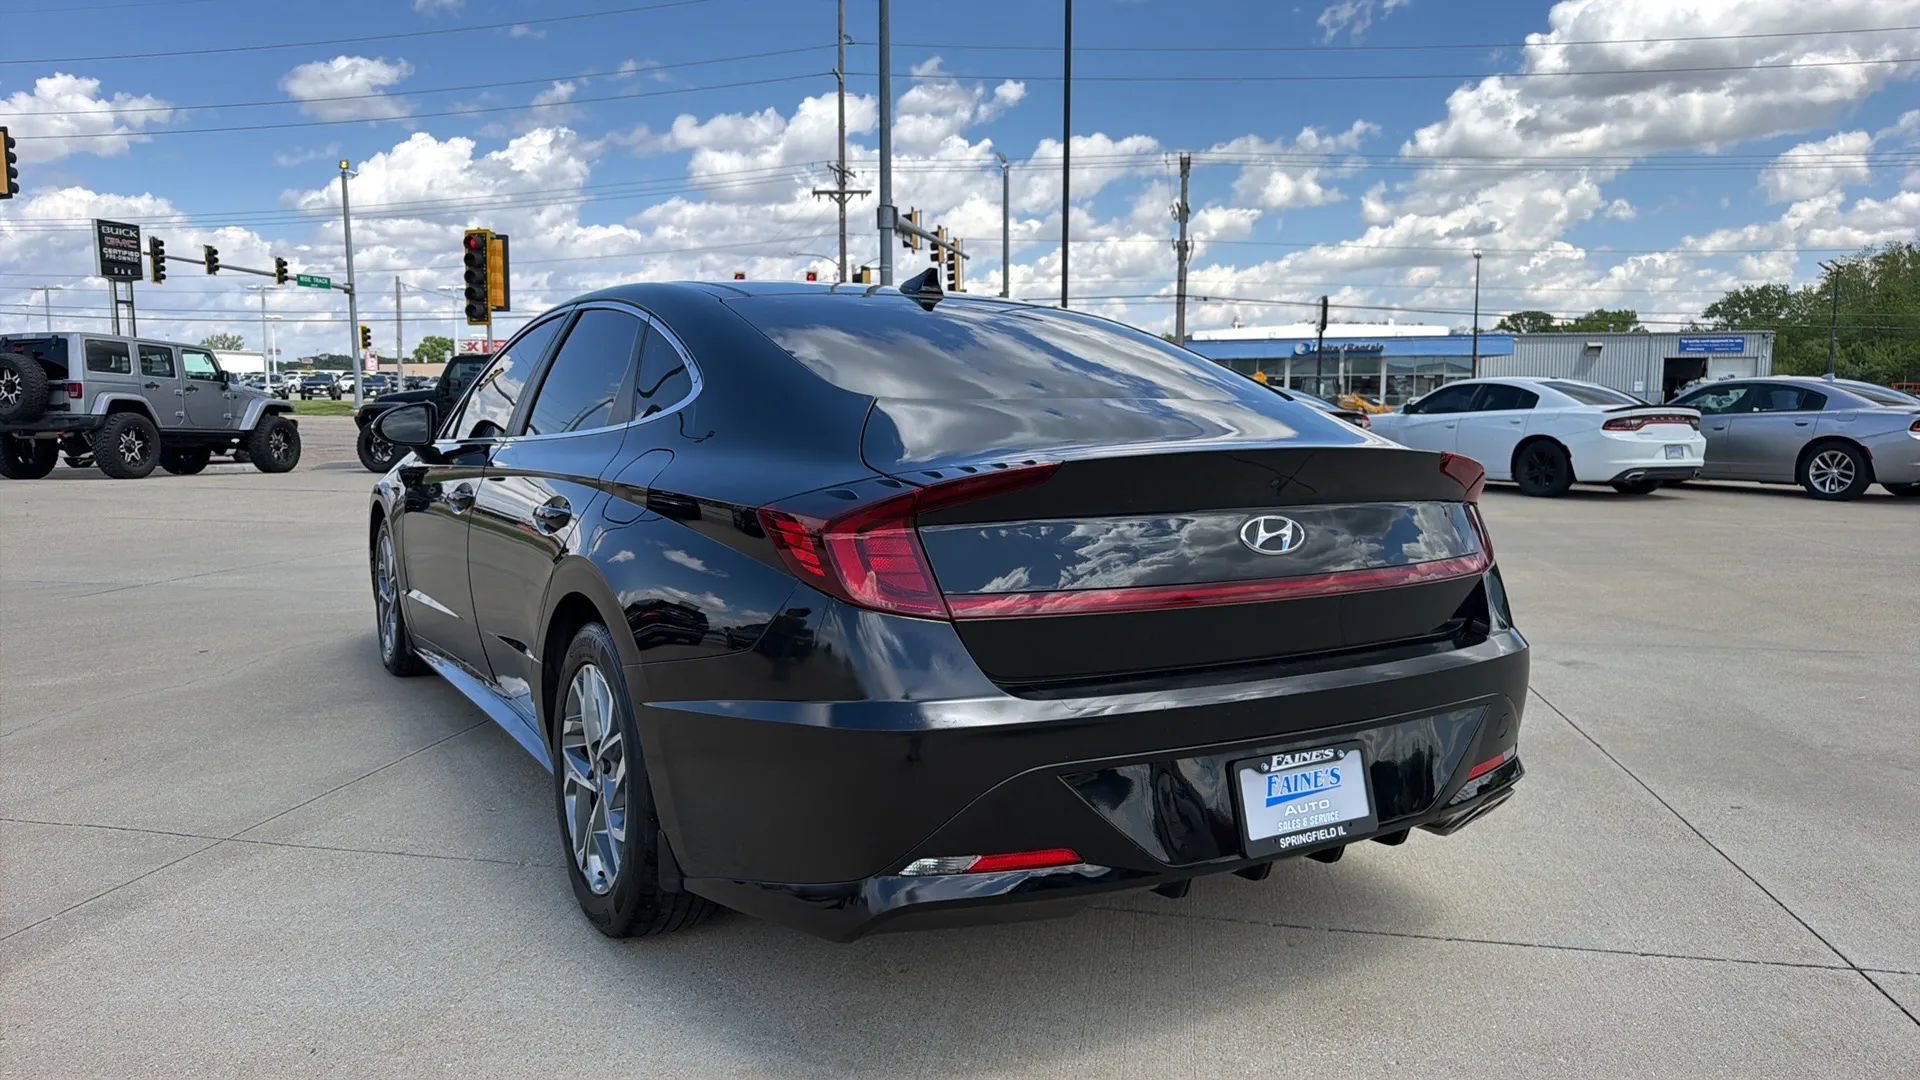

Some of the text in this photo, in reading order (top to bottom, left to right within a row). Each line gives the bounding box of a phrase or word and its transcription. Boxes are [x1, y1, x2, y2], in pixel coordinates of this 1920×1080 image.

[102, 226, 138, 238] BUICK
[104, 236, 137, 248] GMC
[103, 247, 139, 257] CERTIFIED
[1271, 749, 1334, 767] FAINE'S
[1266, 767, 1342, 797] FAINE'S
[1285, 799, 1330, 816] AUTO
[1278, 818, 1301, 832] SALES
[1310, 811, 1339, 826] SERVICE
[1280, 826, 1347, 848] SPRINGFIELD IL
